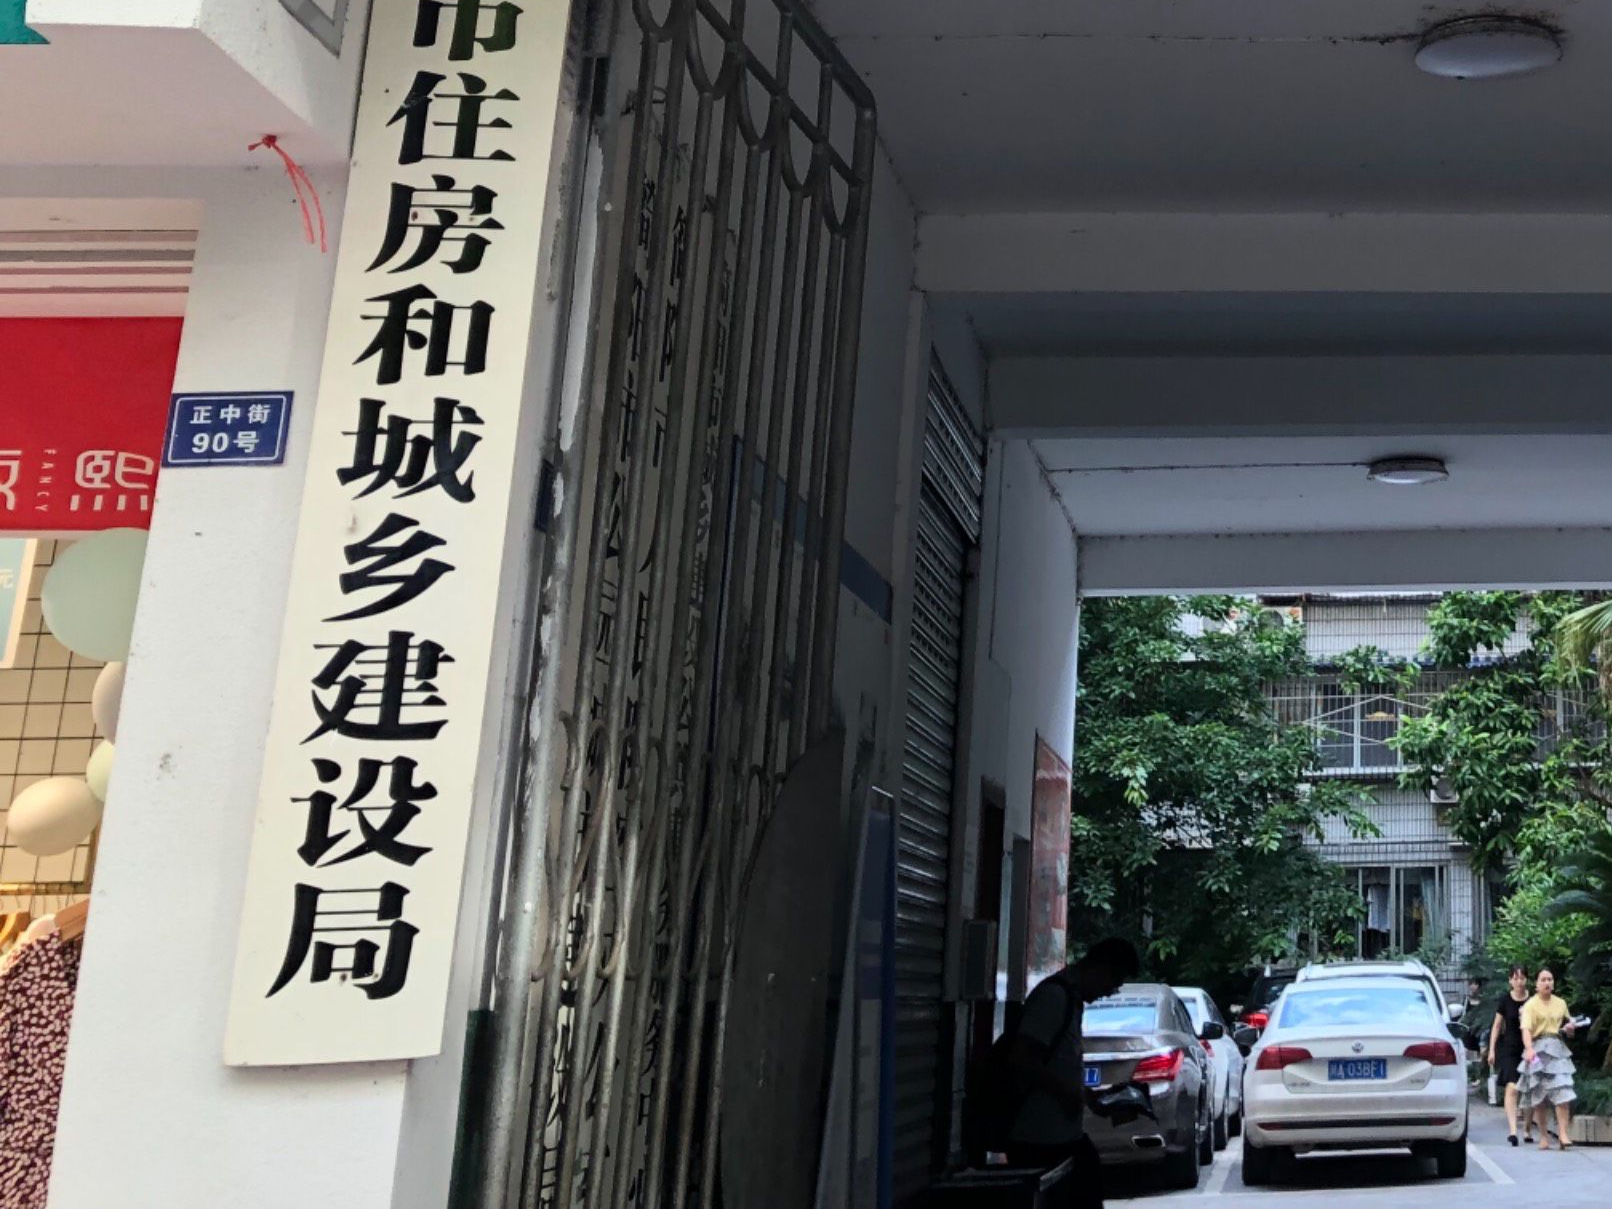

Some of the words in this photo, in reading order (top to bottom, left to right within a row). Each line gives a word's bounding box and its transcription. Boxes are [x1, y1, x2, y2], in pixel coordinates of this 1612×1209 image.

[189, 403, 271, 424] 正中街
[191, 431, 260, 454] 90号
[34, 448, 57, 512] FANCY
